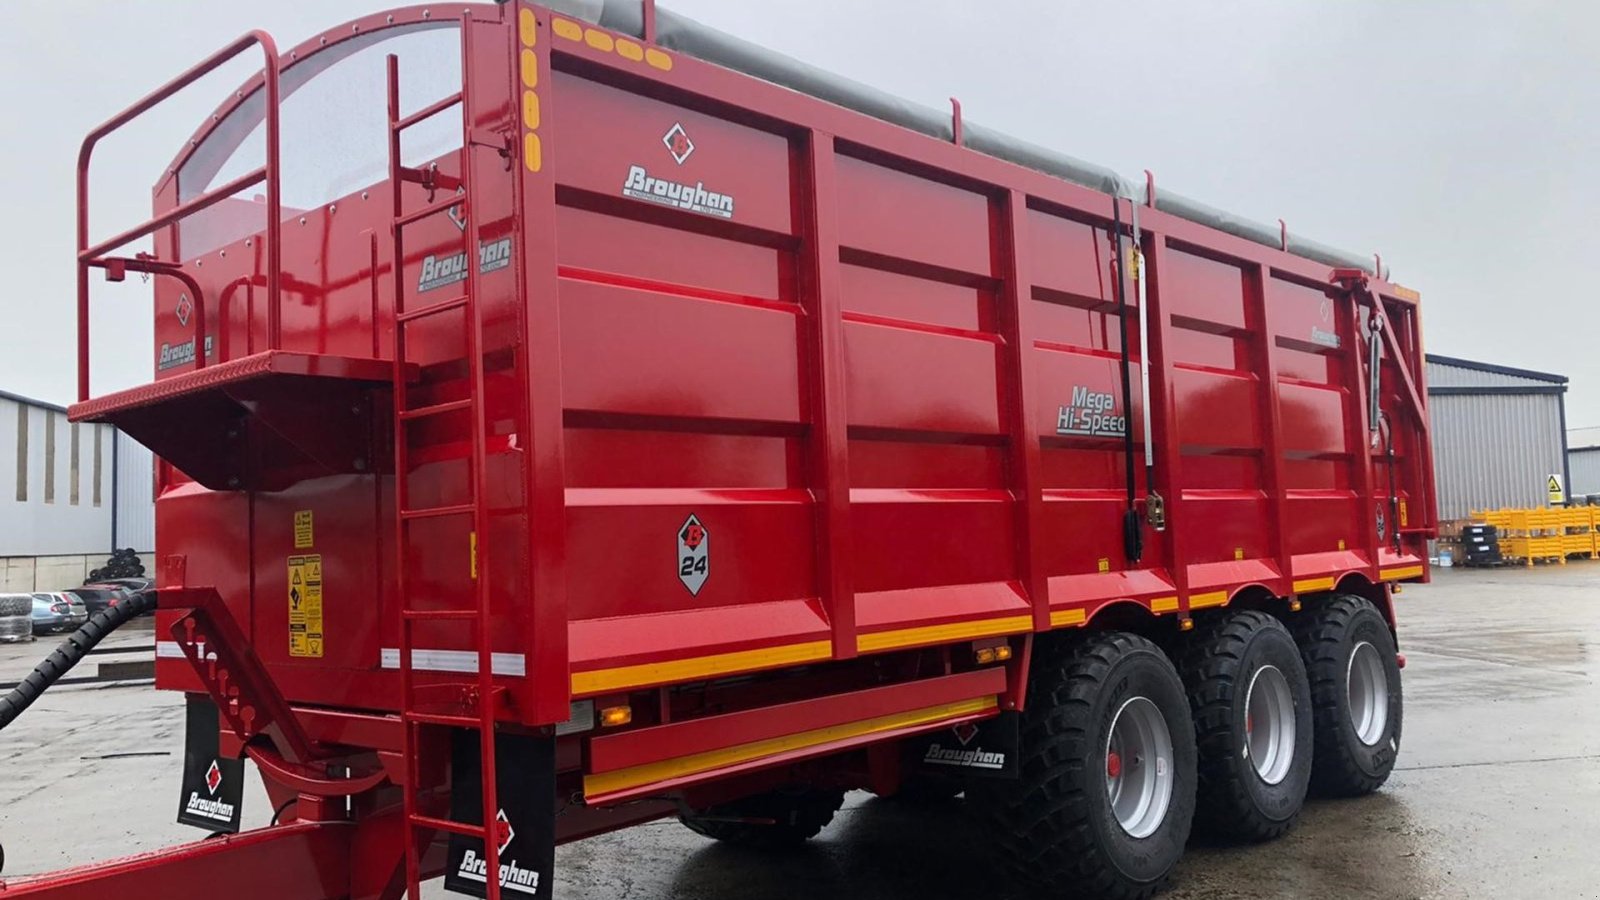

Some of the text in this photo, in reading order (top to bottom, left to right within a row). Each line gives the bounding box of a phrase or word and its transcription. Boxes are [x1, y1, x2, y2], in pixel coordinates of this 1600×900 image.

[624, 165, 733, 211] Broughan
[159, 336, 212, 363] Brougn
[1072, 386, 1113, 413] Mega
[681, 556, 707, 576] 24
[925, 744, 1005, 766] Broughan
[187, 791, 234, 817] Broughan
[460, 849, 540, 887] Broghan
